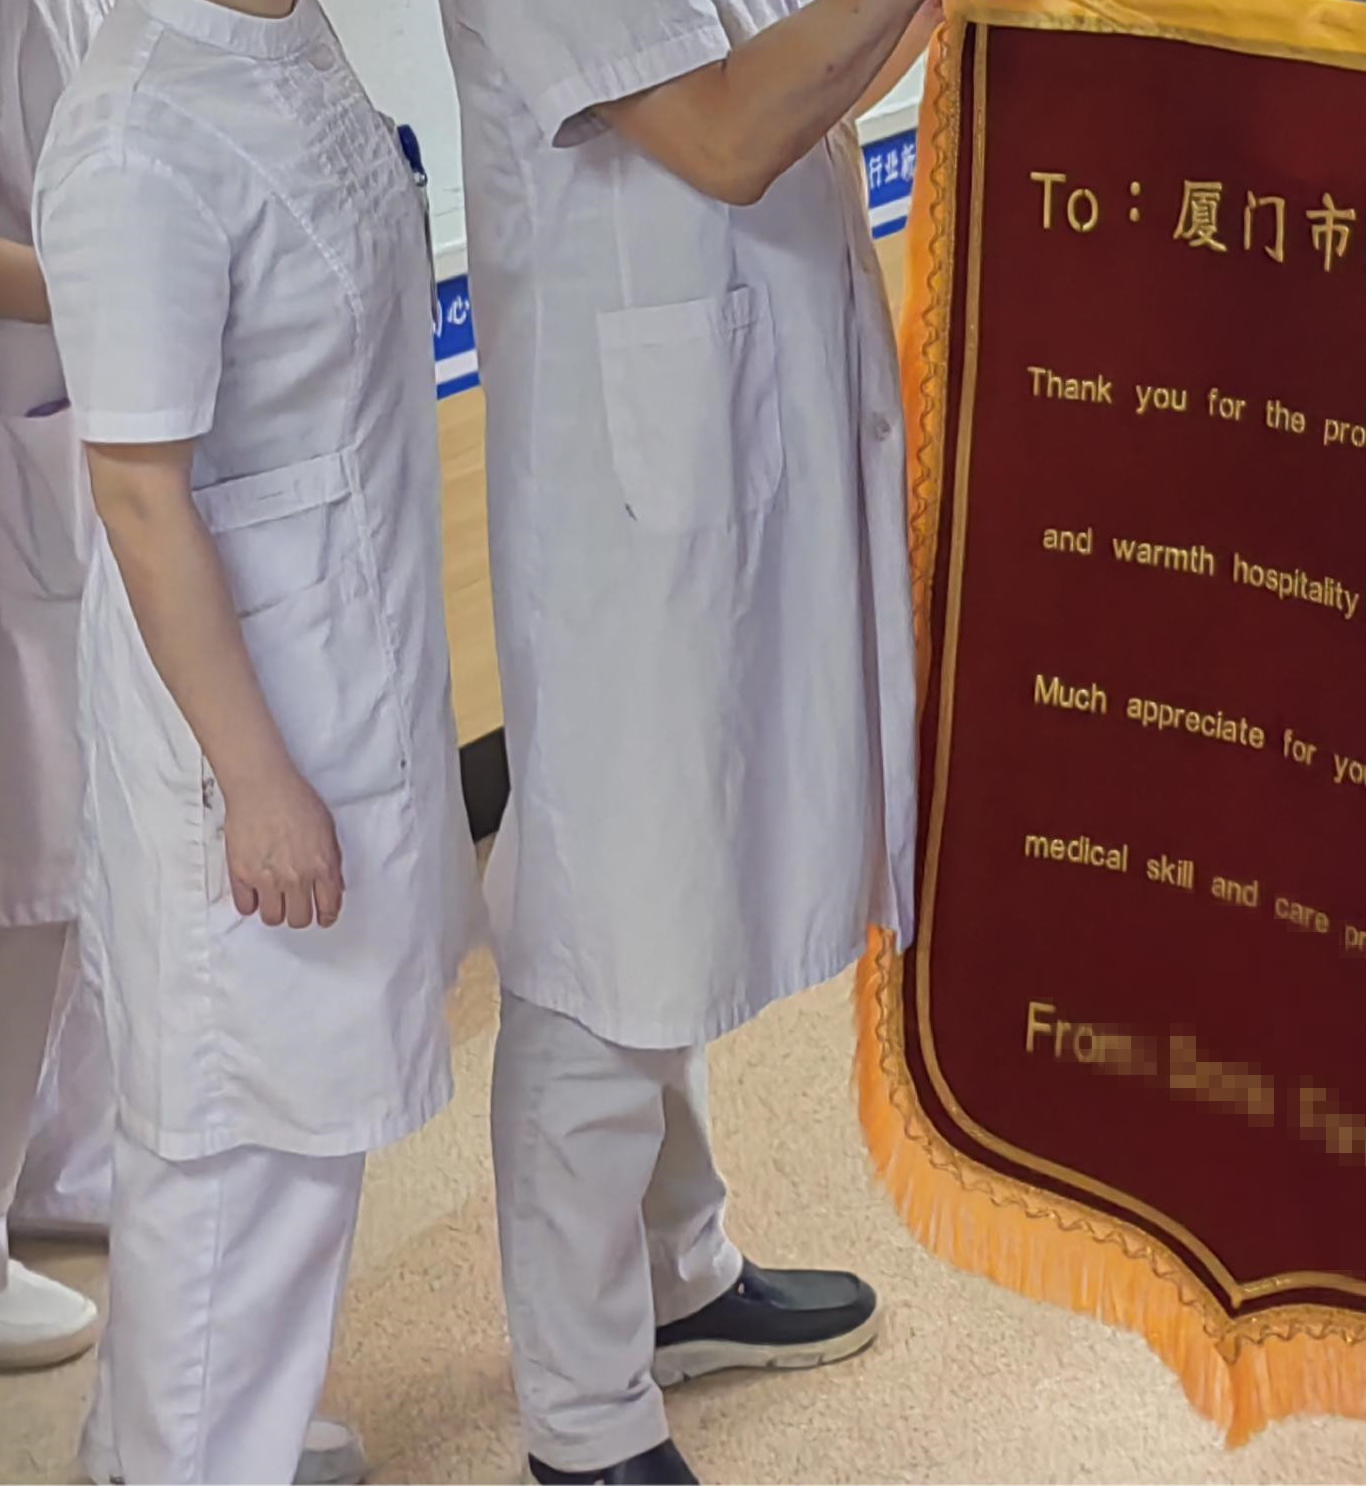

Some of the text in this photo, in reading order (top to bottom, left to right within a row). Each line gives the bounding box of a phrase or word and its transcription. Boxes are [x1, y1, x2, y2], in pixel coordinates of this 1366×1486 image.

[1026, 365, 1113, 405] Thank
[1134, 384, 1188, 416] you
[1208, 386, 1248, 422] for
[1265, 398, 1307, 435] the
[1041, 526, 1094, 556] and
[1111, 537, 1216, 577] warmth
[1232, 551, 1361, 621] hospitality
[1033, 673, 1108, 714] Much
[1125, 696, 1266, 750] appreciate
[1282, 727, 1318, 766] for
[1023, 834, 1129, 873] medical
[1145, 853, 1195, 890] skill
[1210, 875, 1260, 908] and
[1273, 896, 1331, 935] care
